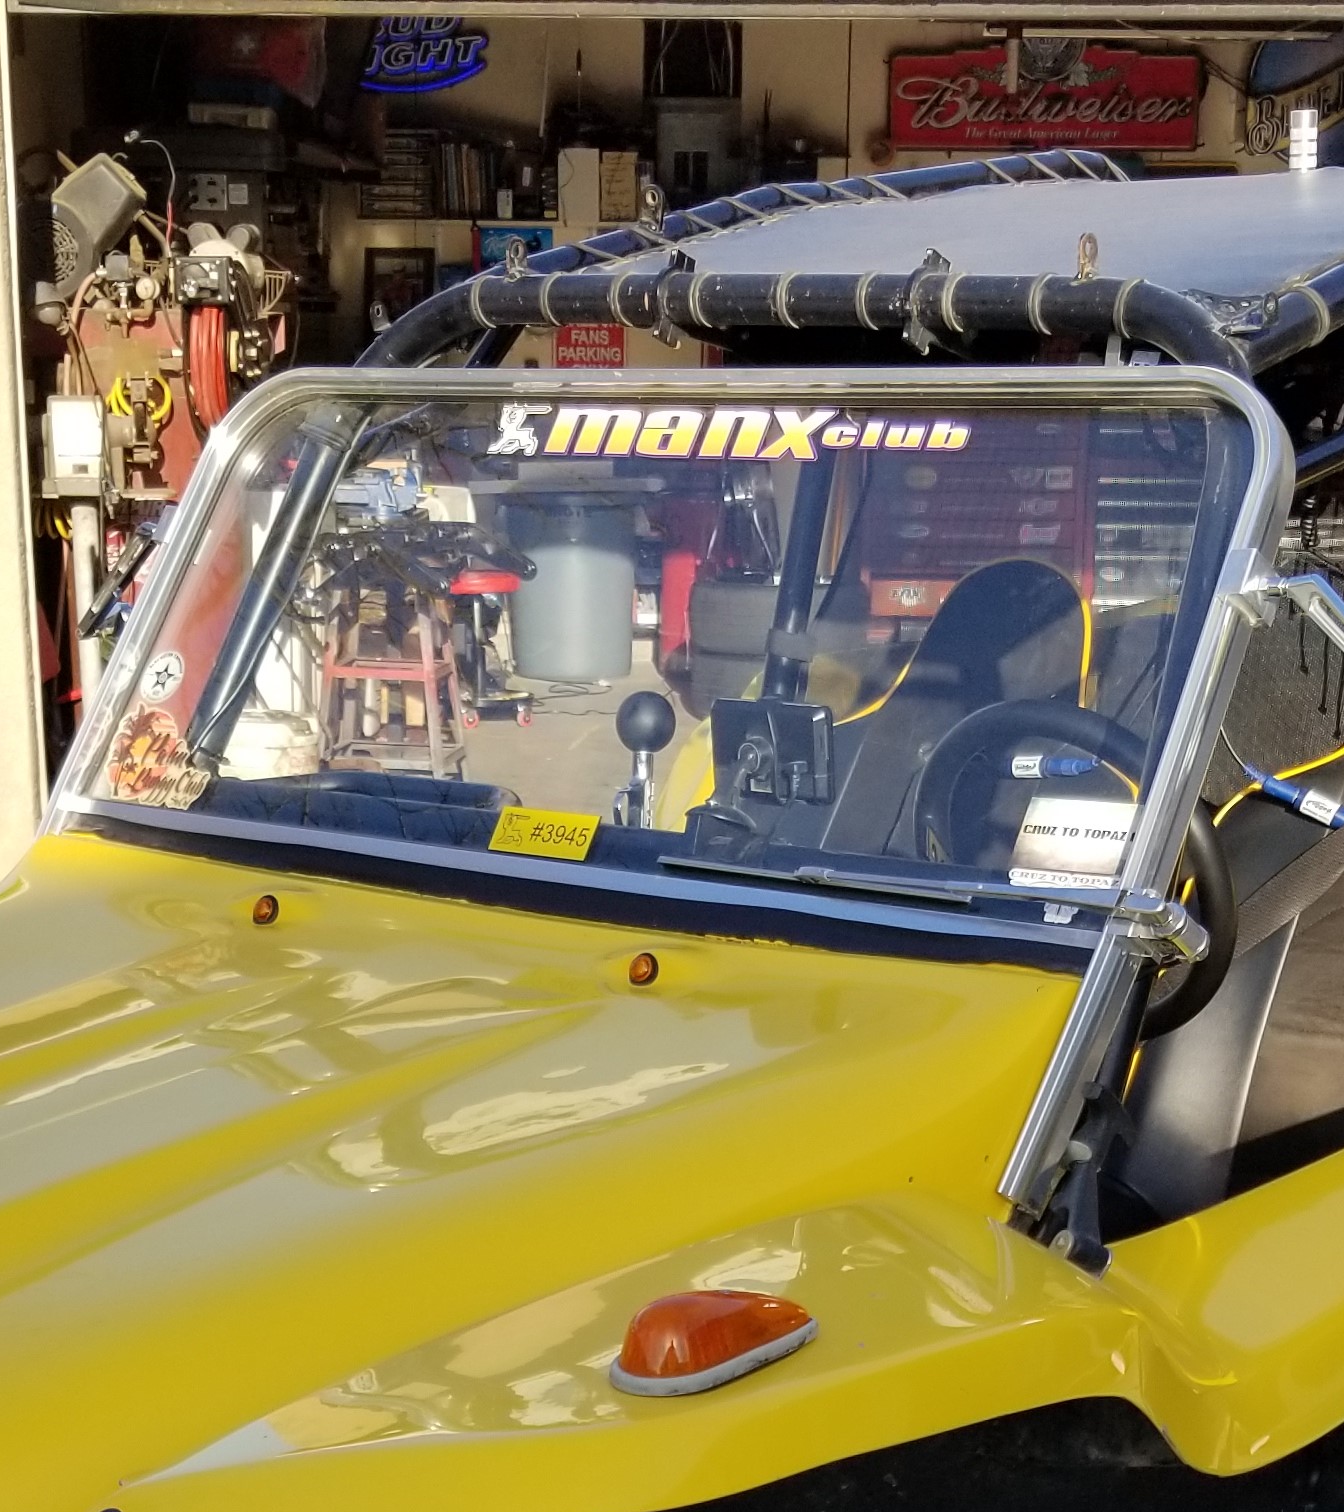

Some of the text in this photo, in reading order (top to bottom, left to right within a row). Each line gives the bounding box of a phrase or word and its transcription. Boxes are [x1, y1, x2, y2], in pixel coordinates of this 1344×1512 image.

[377, 16, 460, 40] UD
[896, 76, 1191, 129] Budweiser
[965, 127, 985, 139] The
[1025, 127, 1081, 139] American
[1084, 127, 1120, 141] Lager
[570, 329, 609, 345] FANS
[558, 347, 622, 363] PARKING
[543, 404, 972, 461] manx club
[176, 772, 209, 796] Club
[530, 822, 590, 847] #3945
[1023, 824, 1057, 836] CRUZ
[1062, 827, 1079, 837] TO
[1084, 828, 1128, 841] TOPAZ
[1011, 870, 1047, 881] CRUZ
[1050, 872, 1068, 882] TO
